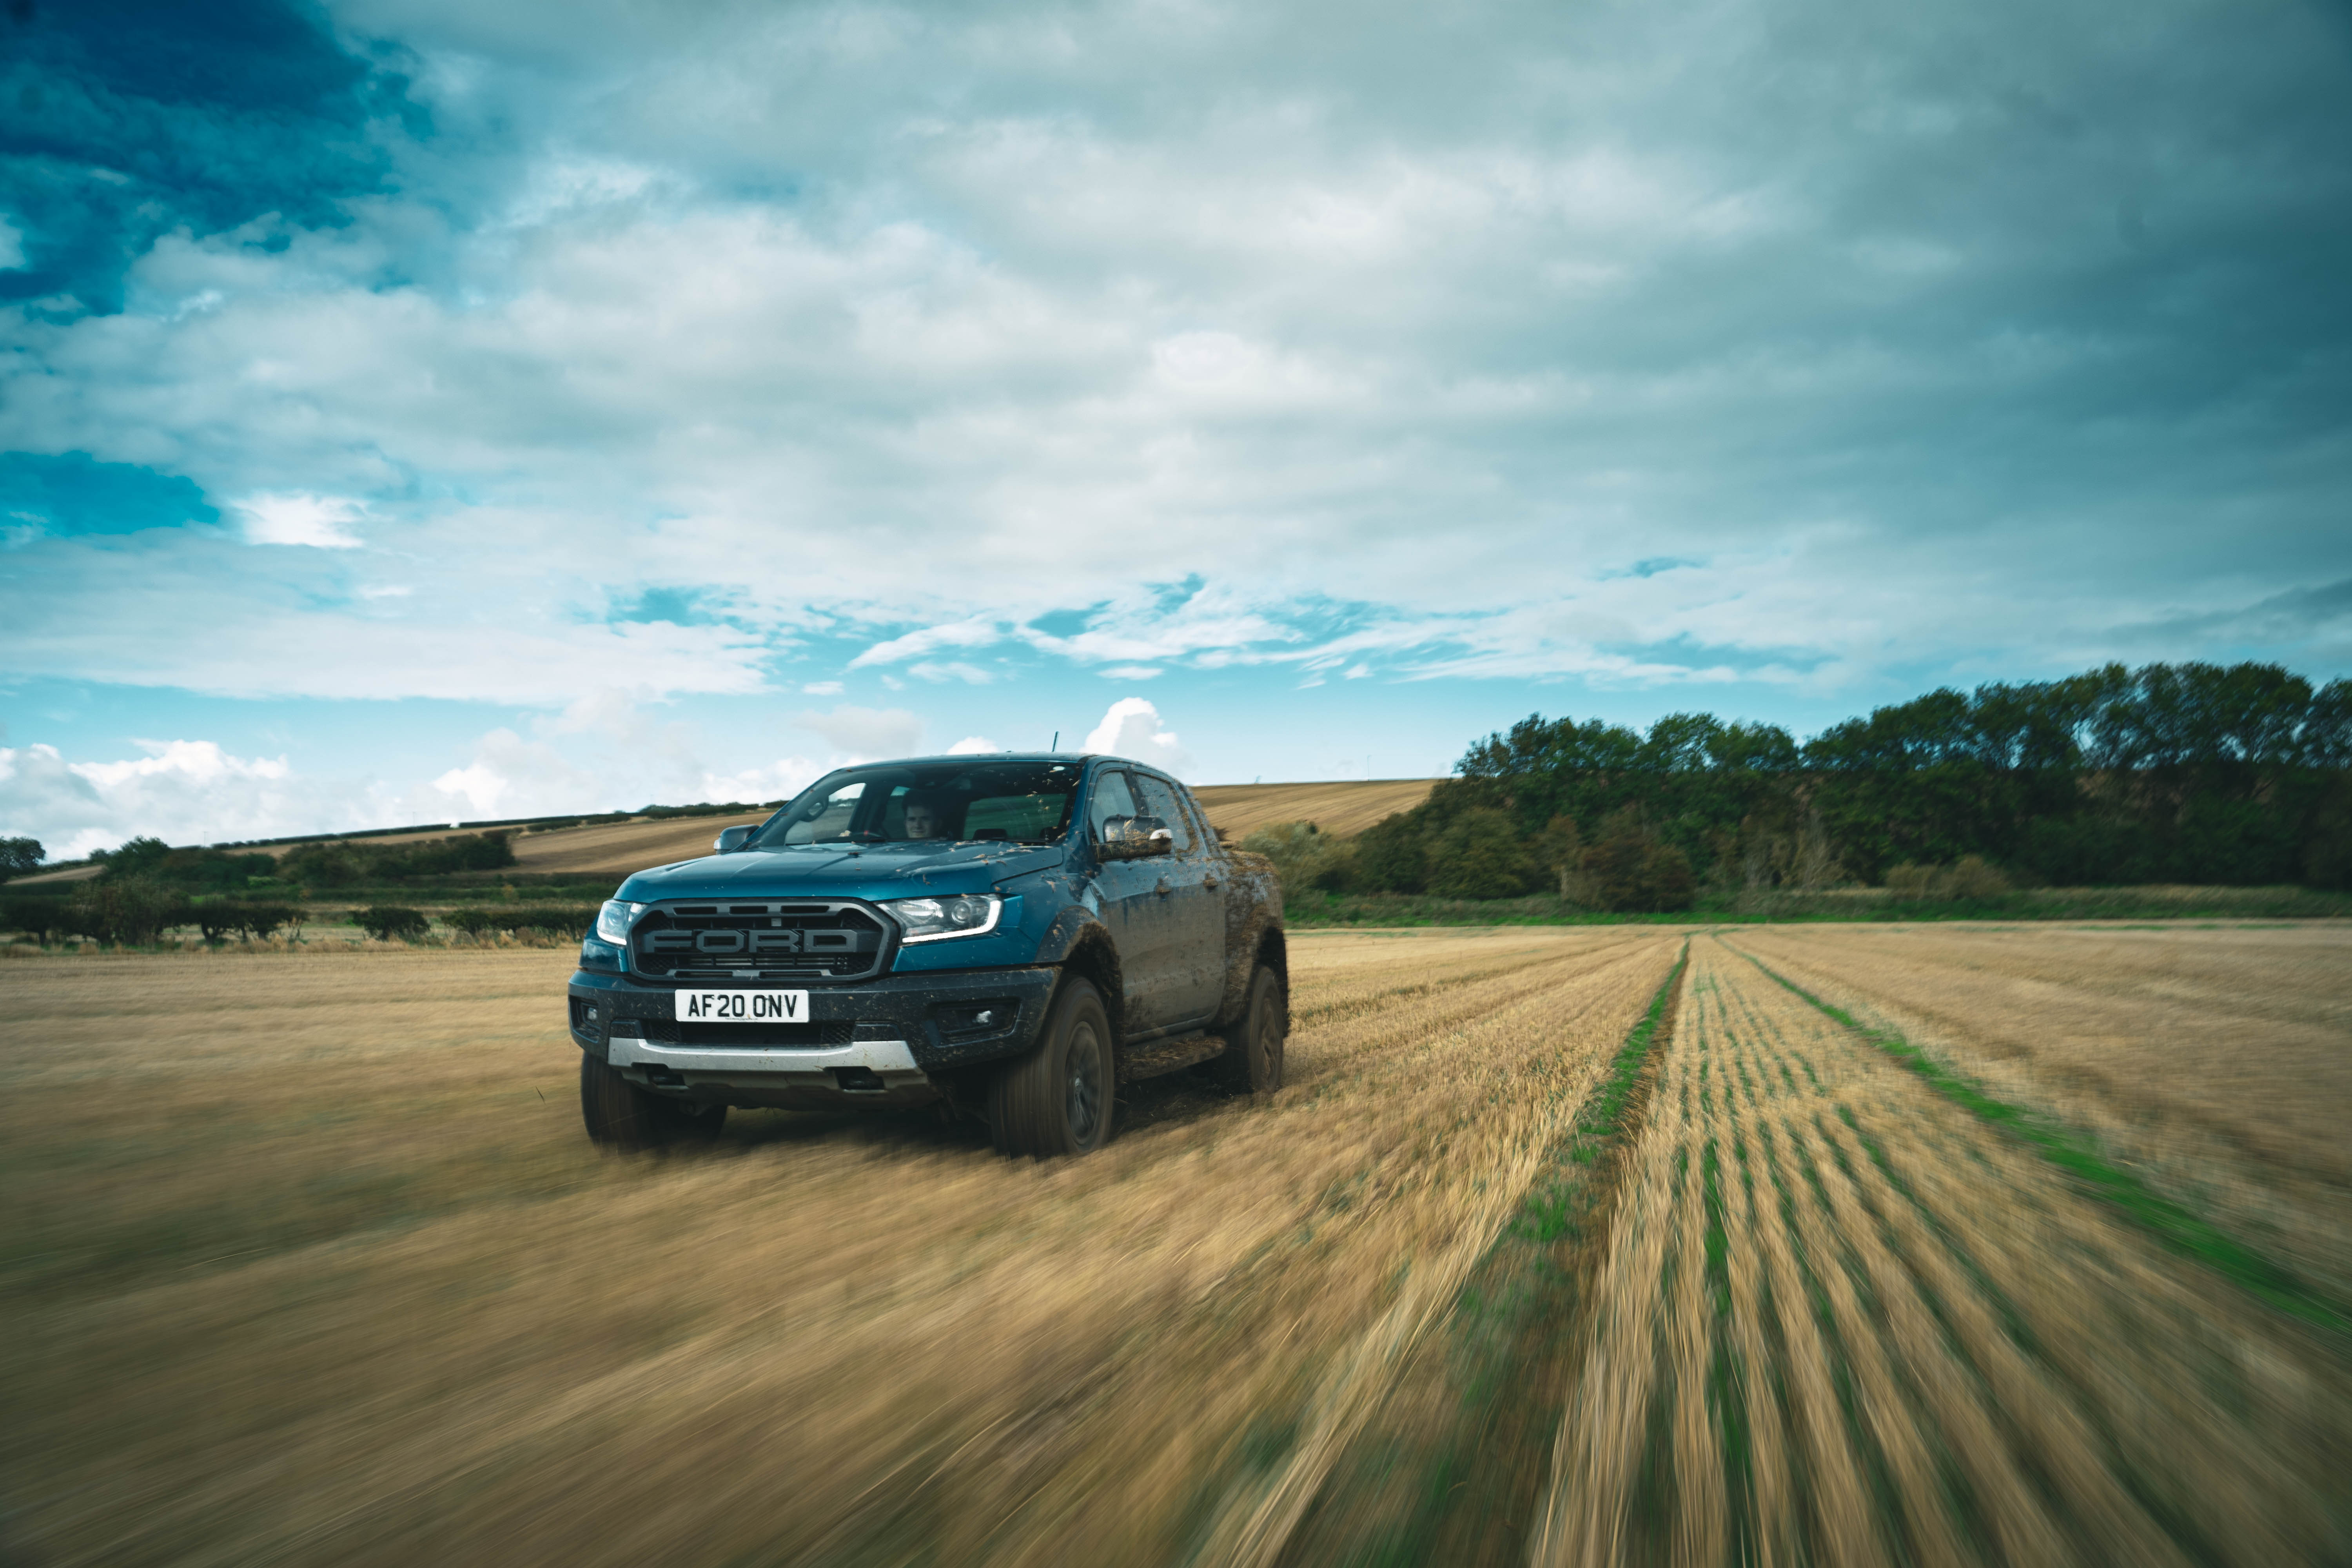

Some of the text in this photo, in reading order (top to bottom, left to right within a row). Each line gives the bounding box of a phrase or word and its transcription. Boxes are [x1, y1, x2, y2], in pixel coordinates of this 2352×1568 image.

[644, 929, 857, 953] FORD
[688, 994, 797, 1018] AF20 ONV
